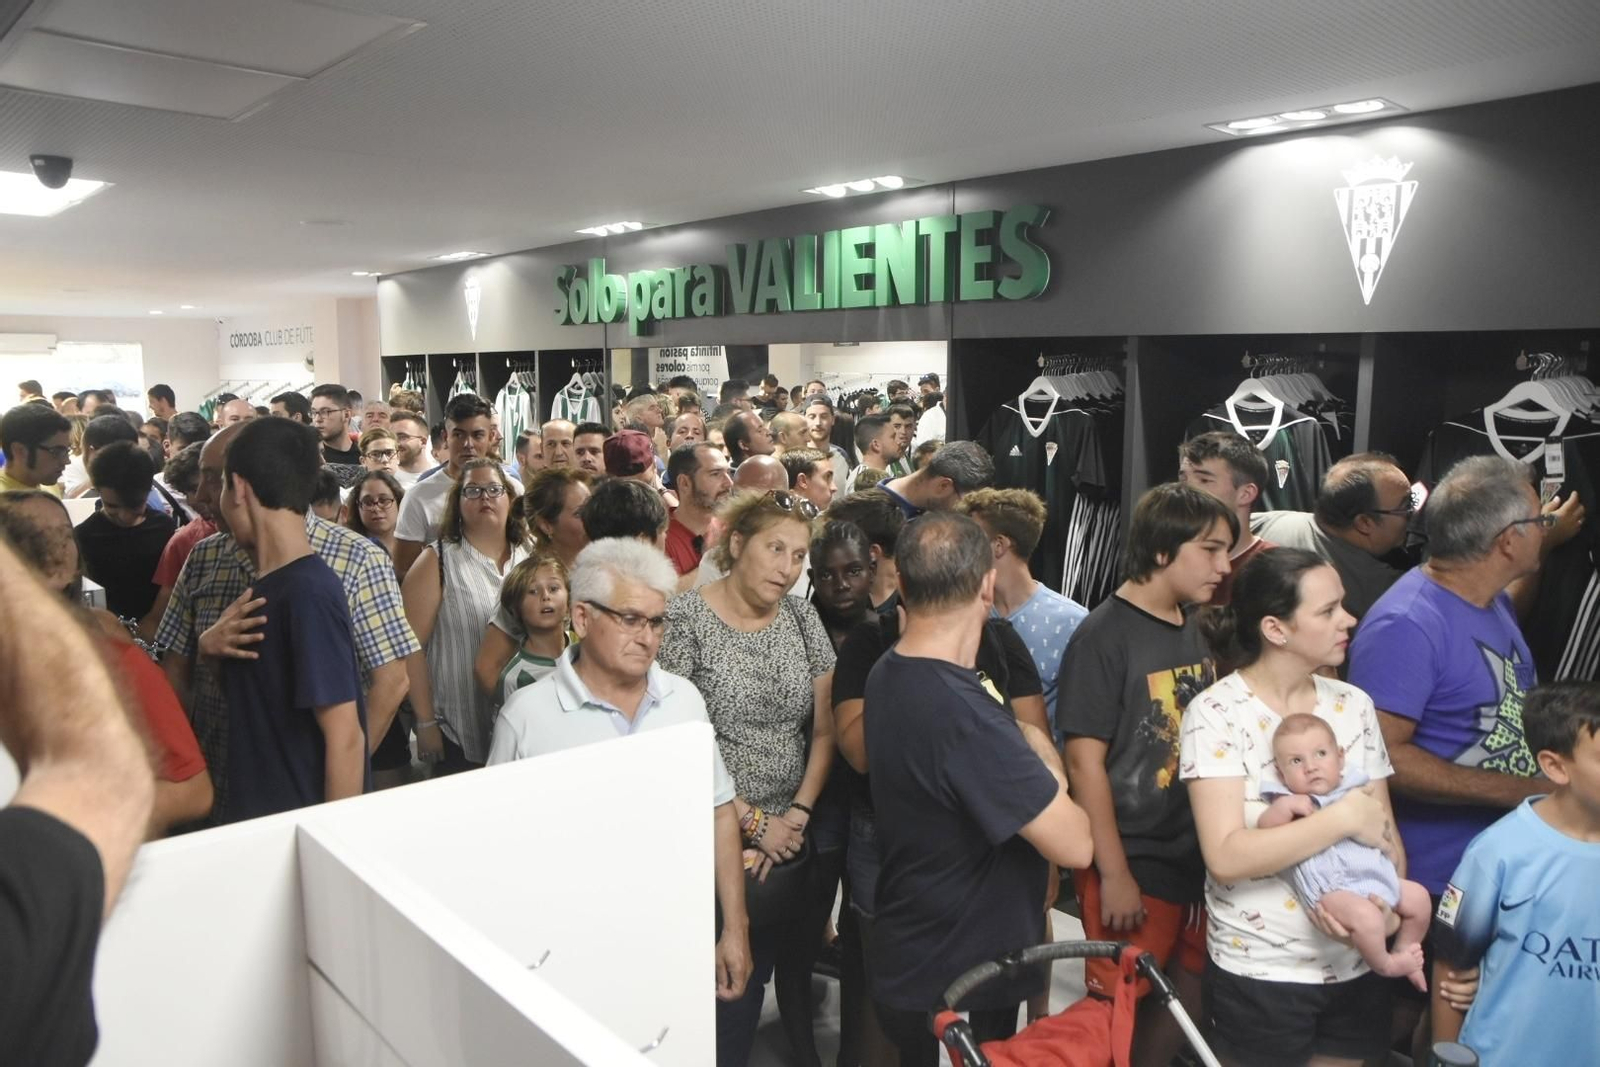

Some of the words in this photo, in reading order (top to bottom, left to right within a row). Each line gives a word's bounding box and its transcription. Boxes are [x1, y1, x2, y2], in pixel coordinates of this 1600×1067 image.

[552, 258, 628, 326] Solo
[628, 265, 722, 336] para
[727, 204, 1051, 314] VALIENTES
[229, 330, 263, 348] CÓRDOBA
[264, 330, 283, 346] CLUB
[284, 328, 295, 344] DE
